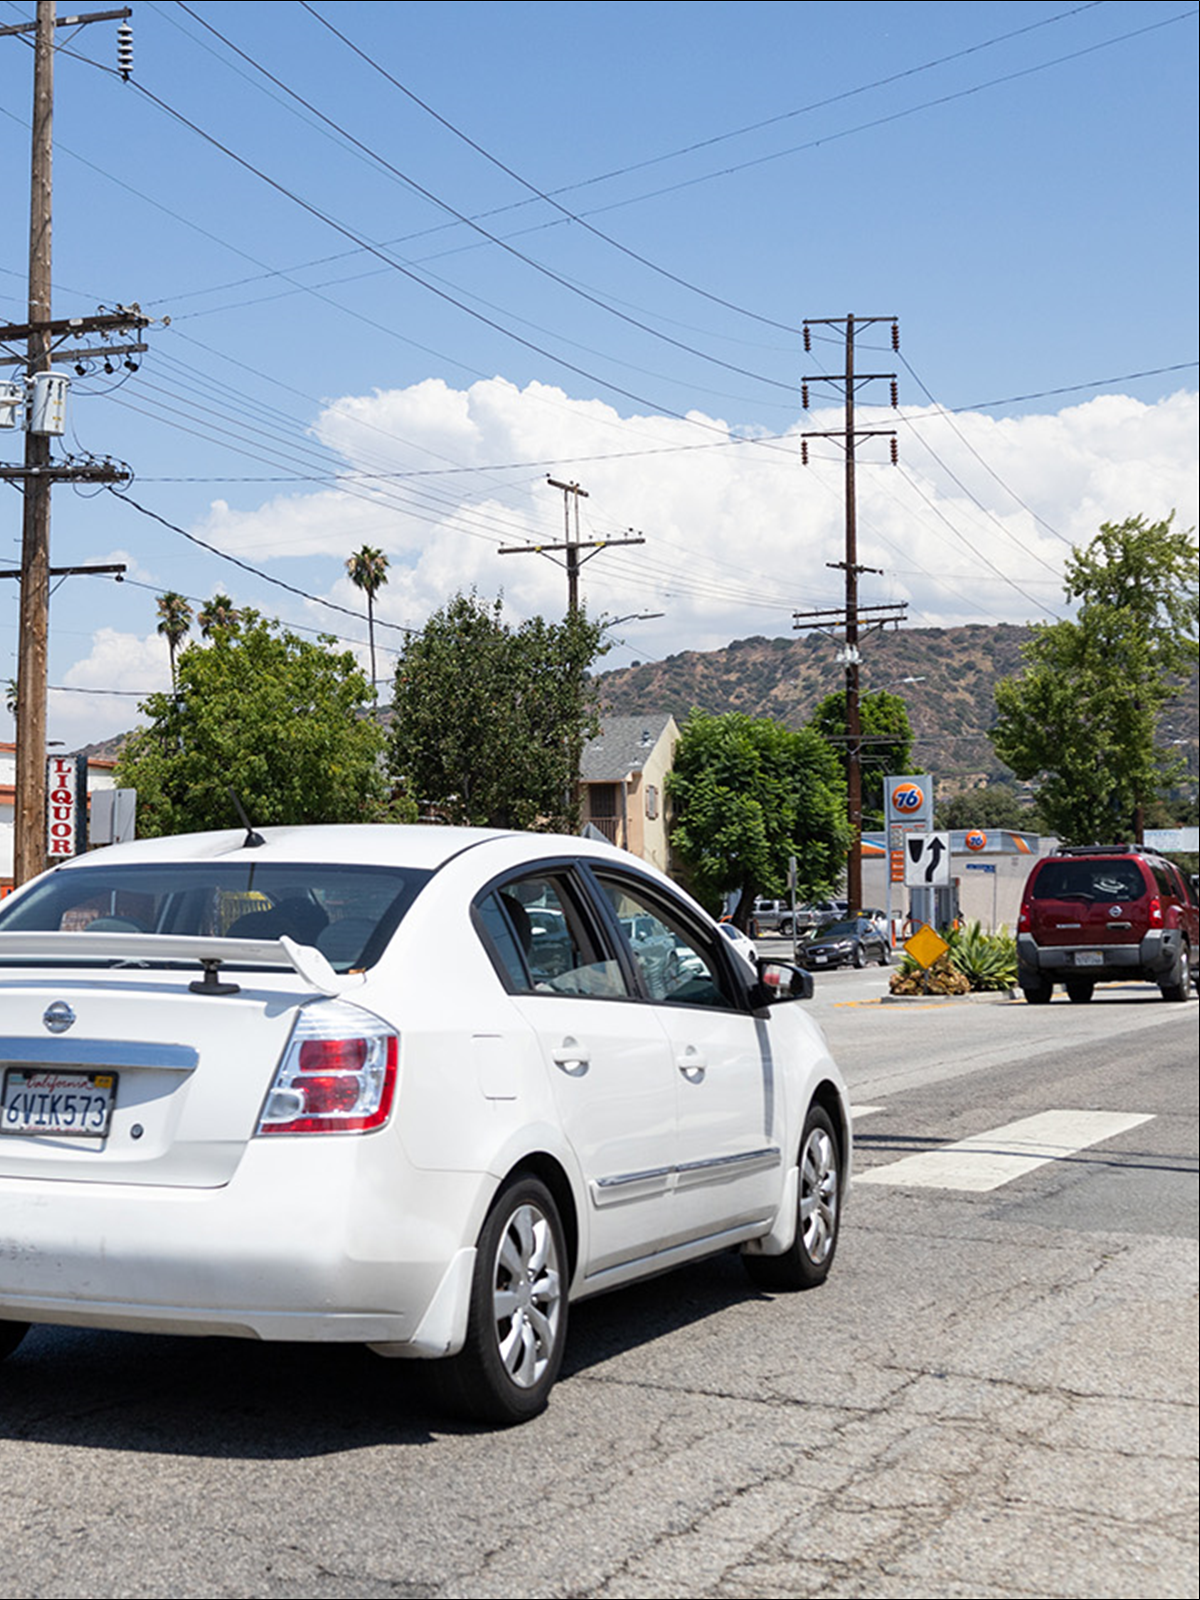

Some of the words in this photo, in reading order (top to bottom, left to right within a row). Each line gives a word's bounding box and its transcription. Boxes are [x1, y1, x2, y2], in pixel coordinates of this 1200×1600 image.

[50, 759, 74, 854] LIQUOR
[896, 789, 919, 808] 76
[970, 835, 984, 847] 76
[26, 1073, 94, 1093] California
[6, 1093, 106, 1128] 6VIK573
